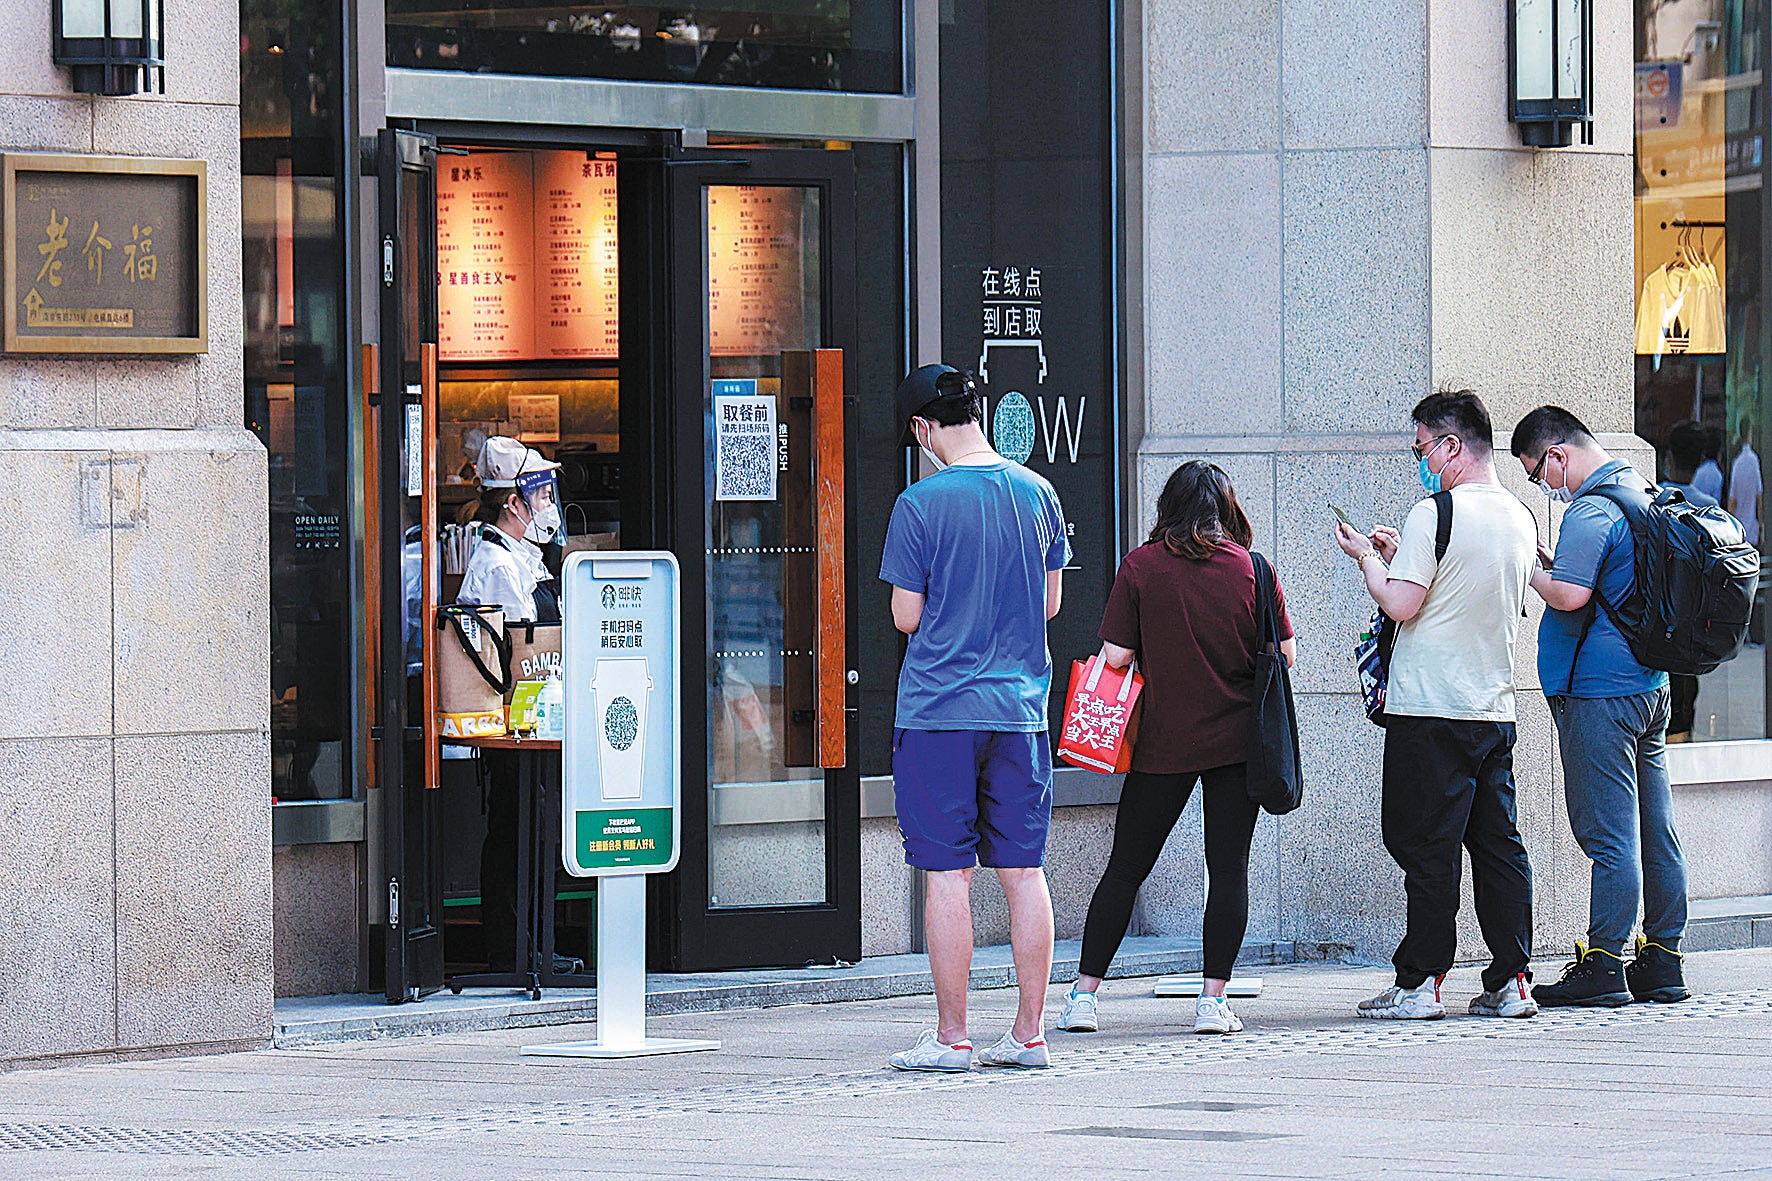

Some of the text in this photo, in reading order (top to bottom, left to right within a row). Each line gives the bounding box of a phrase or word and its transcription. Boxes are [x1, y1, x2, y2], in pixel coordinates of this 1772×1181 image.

[451, 167, 484, 182] 星冰乐
[36, 208, 158, 287] 老介福
[982, 266, 1042, 297] 在线点
[983, 306, 1042, 336] 到店取
[722, 404, 768, 422] 取餐前
[721, 423, 770, 434] 请先扫场所码
[778, 438, 788, 471] PUSH
[295, 515, 340, 525] OPEN DAILY
[601, 620, 643, 633] 手机扫码点
[601, 635, 643, 648] 稍后安心取
[521, 651, 563, 678] BAMB
[1074, 692, 1127, 724] 早点吃
[1064, 724, 1115, 750] 当大王
